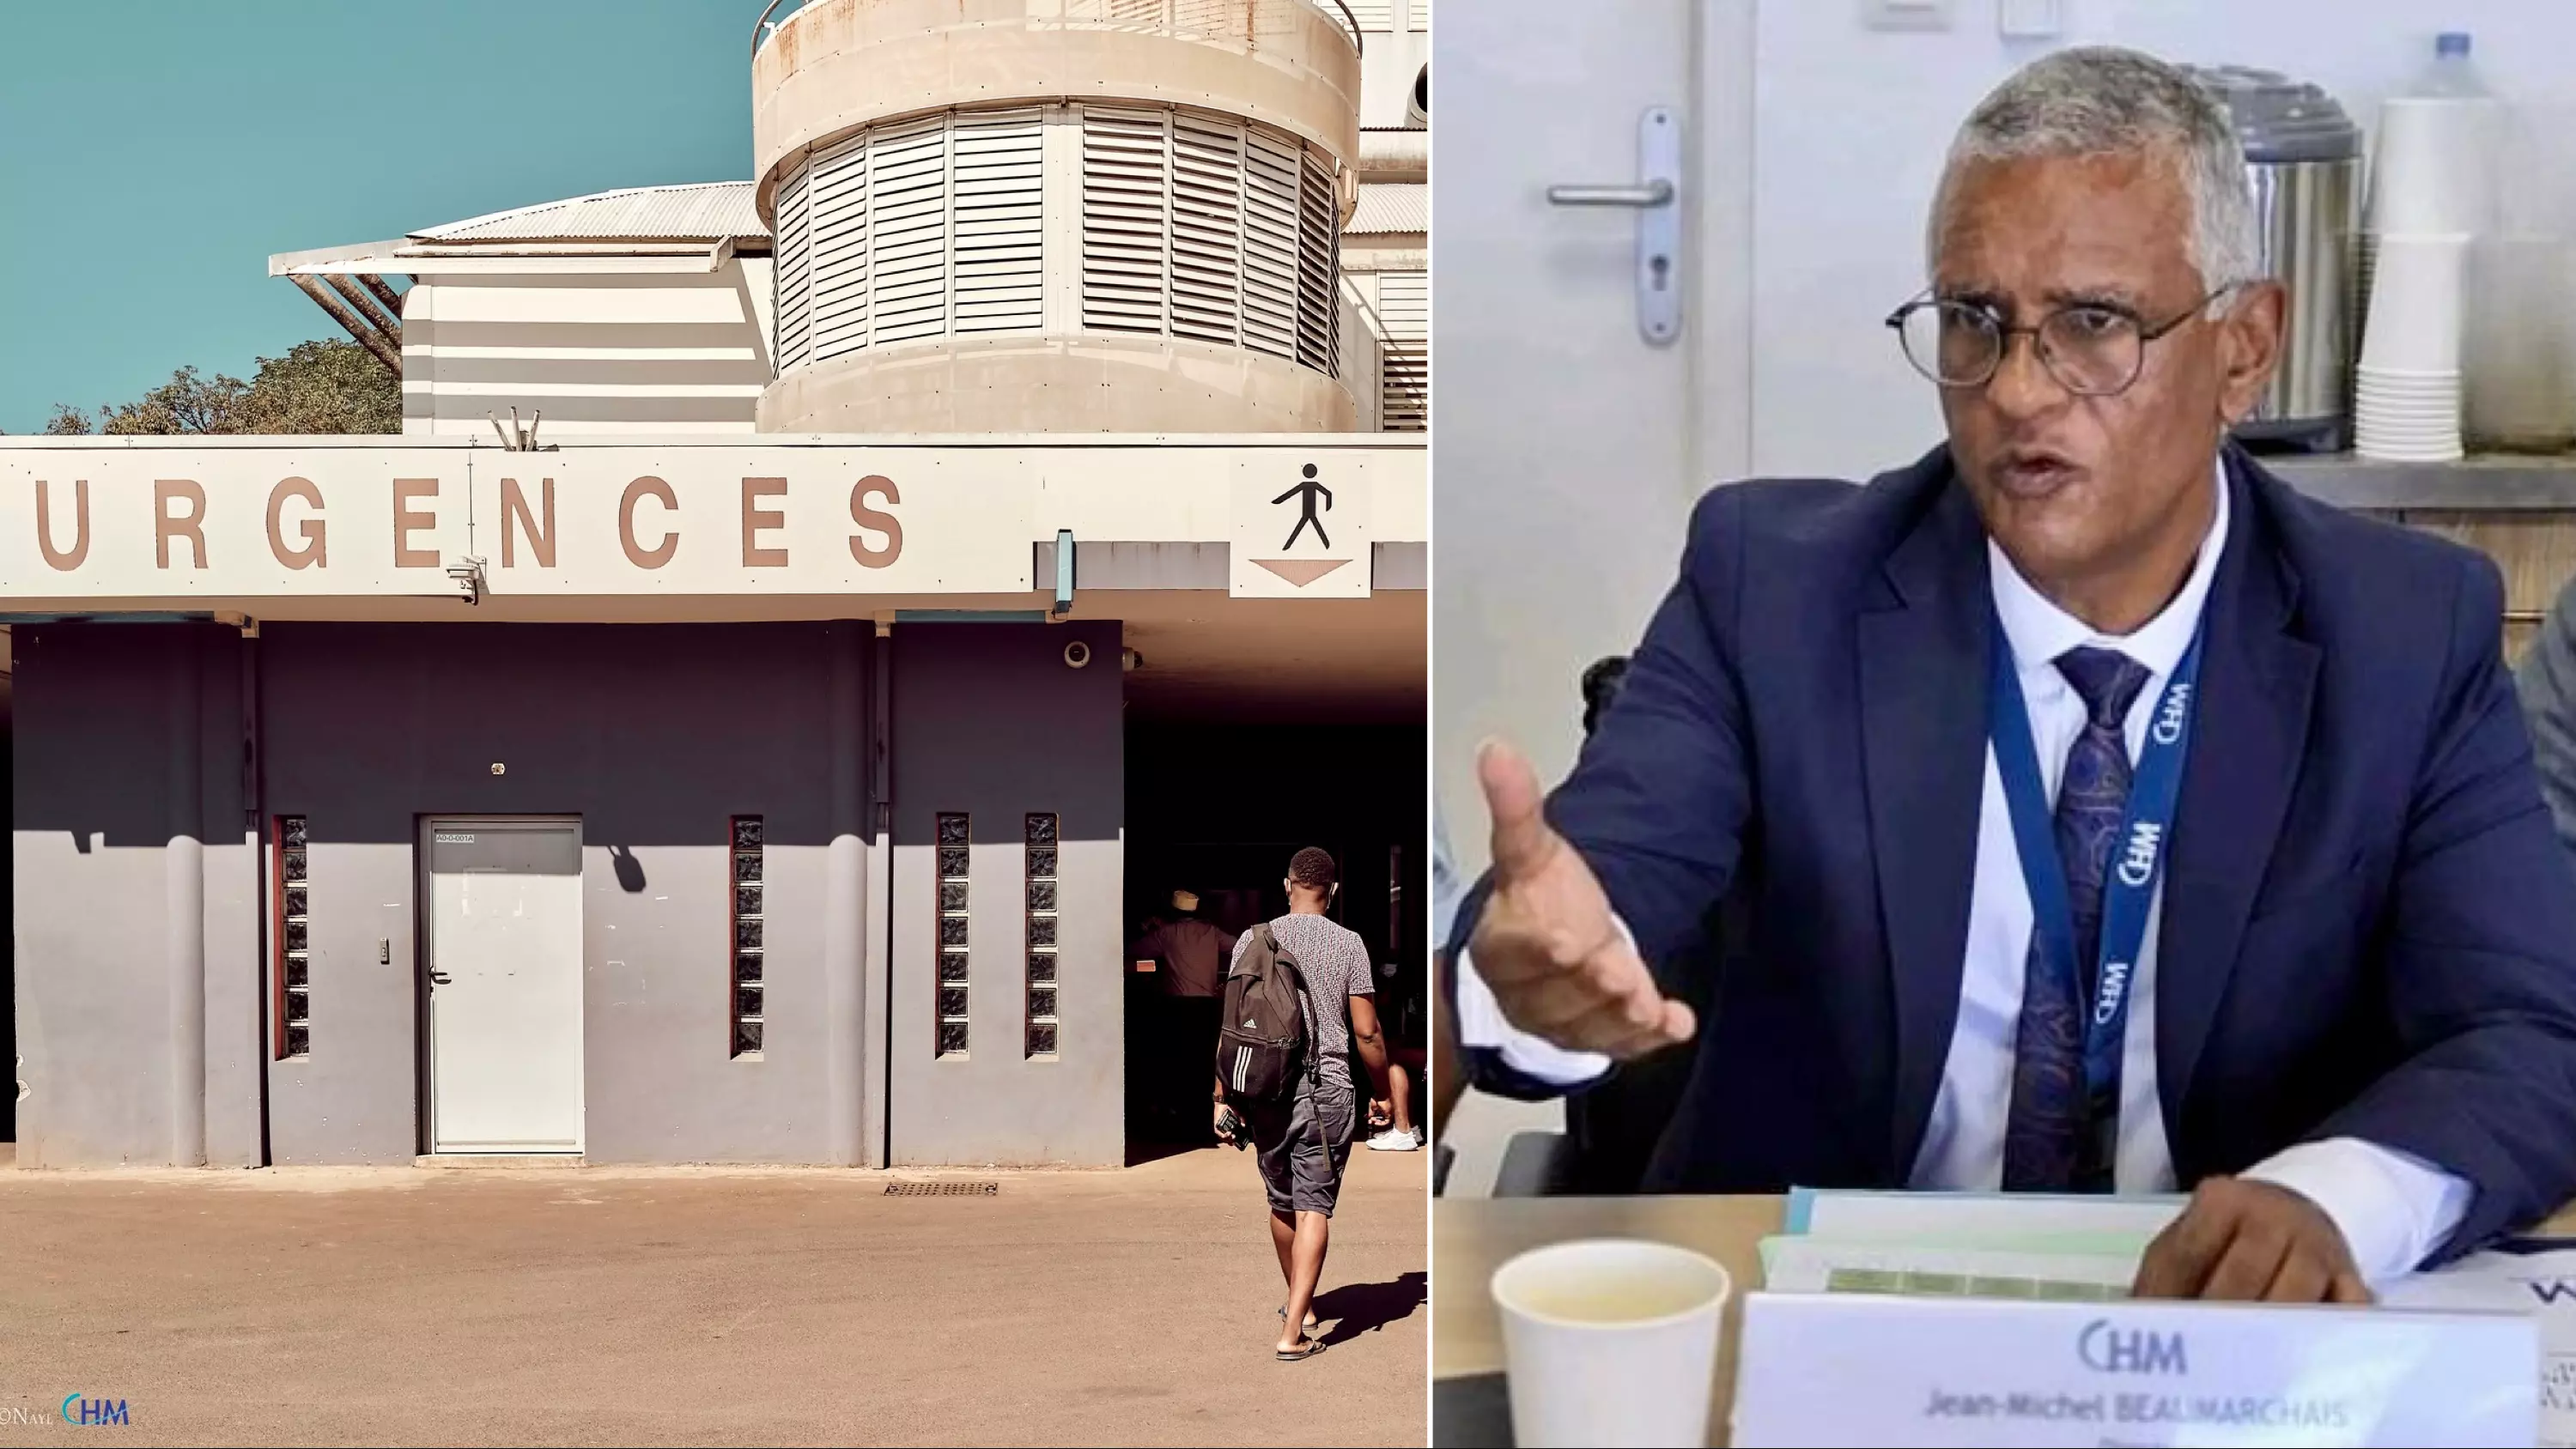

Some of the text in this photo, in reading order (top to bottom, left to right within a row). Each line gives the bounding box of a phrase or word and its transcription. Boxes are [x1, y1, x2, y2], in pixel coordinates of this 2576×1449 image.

[35, 475, 904, 571] URGENCES
[2154, 684, 2190, 744] CHM
[2118, 822, 2160, 886] CHM
[2096, 962, 2127, 1023] CHM
[2077, 1318, 2187, 1374] CHM
